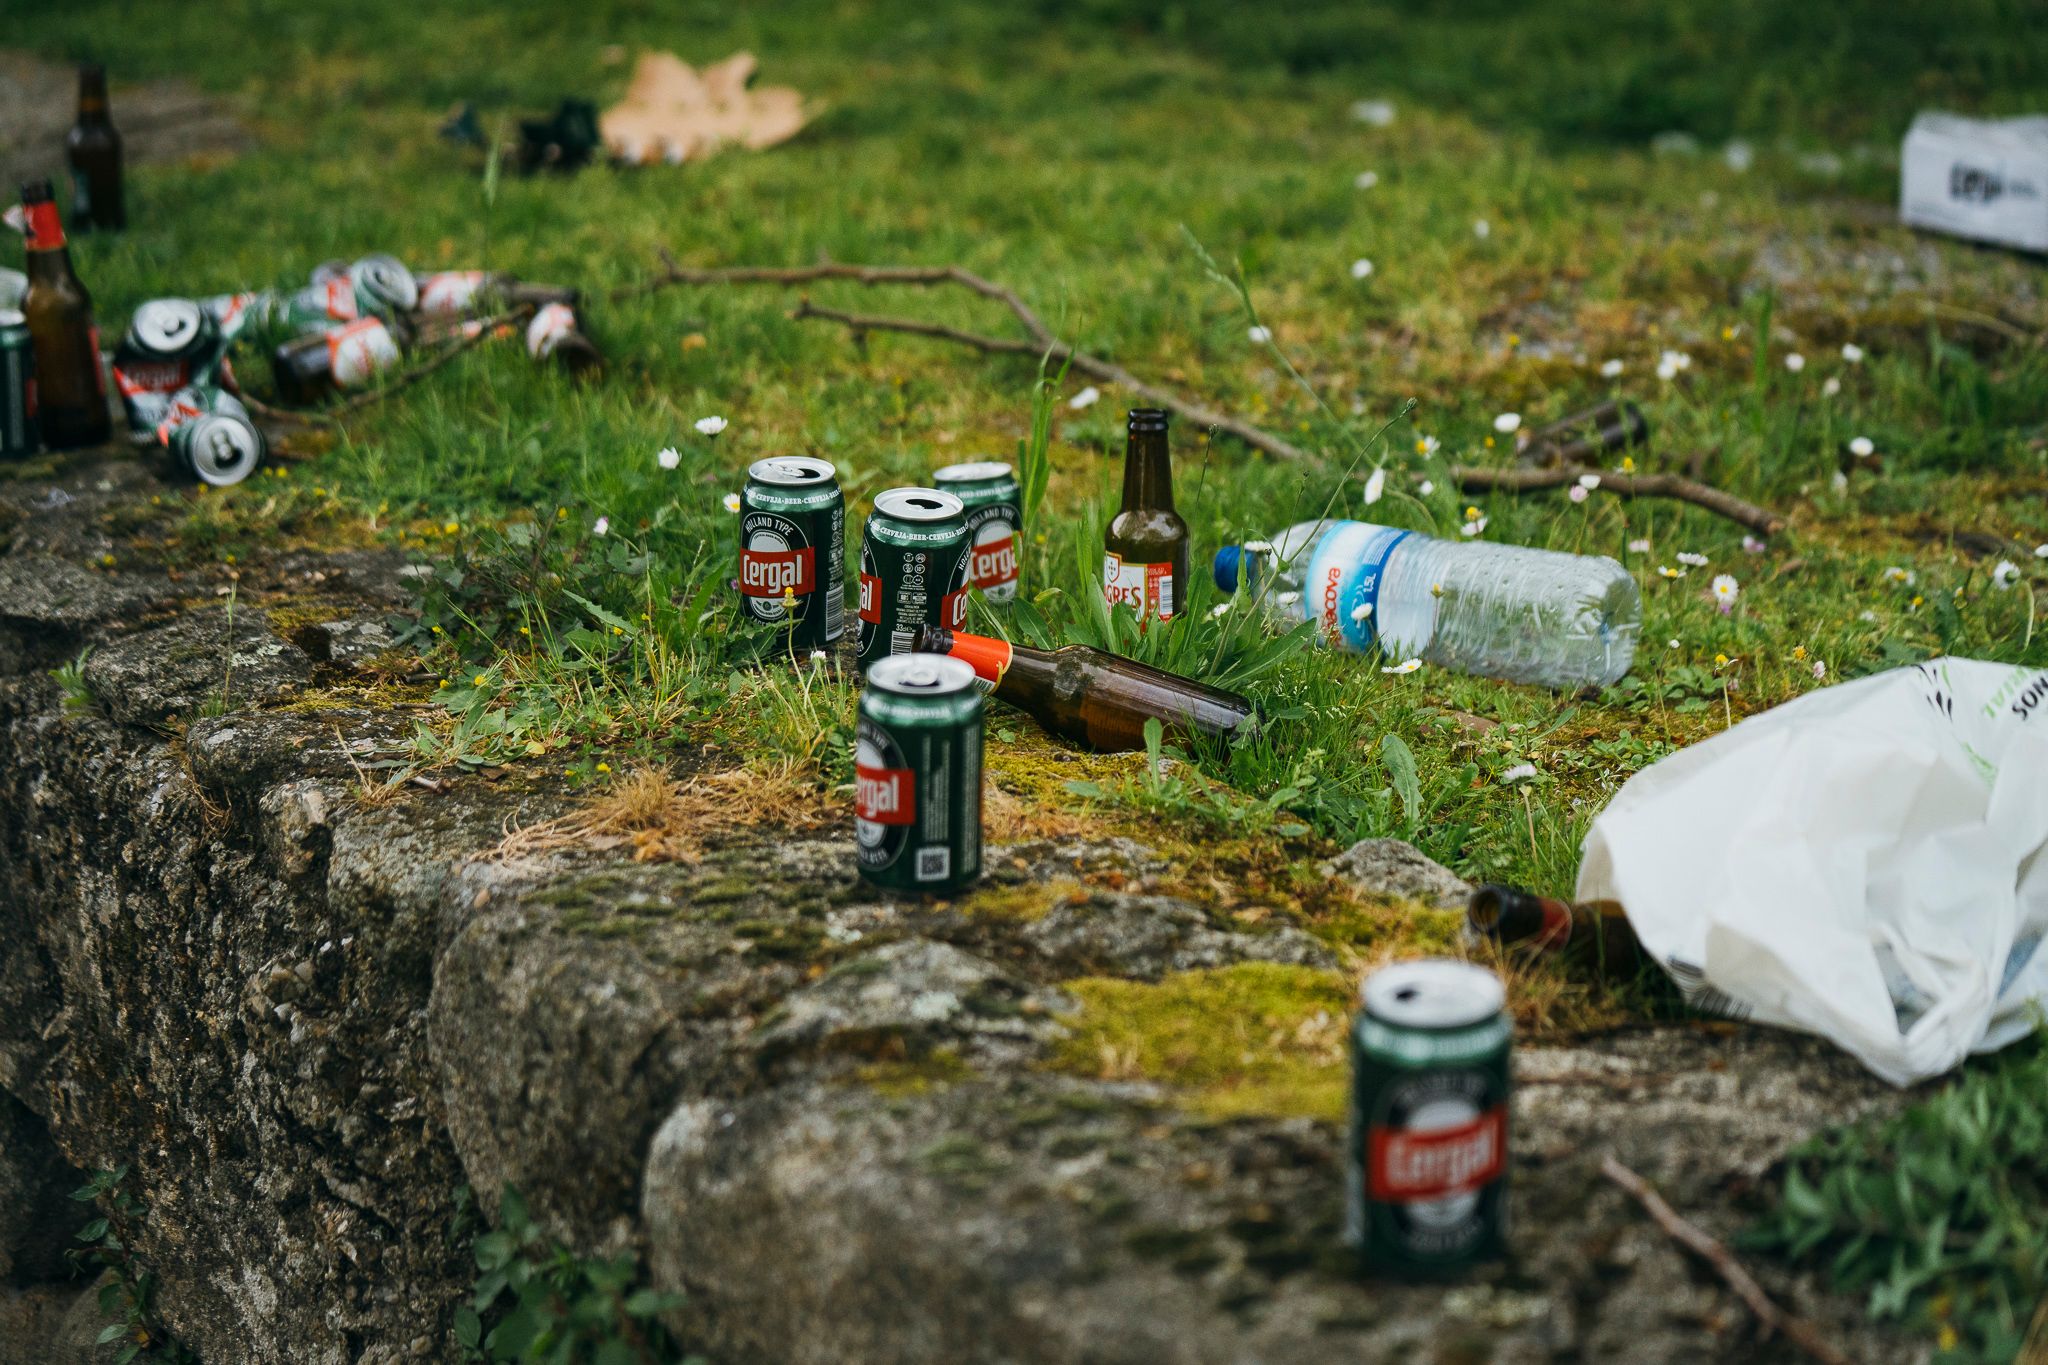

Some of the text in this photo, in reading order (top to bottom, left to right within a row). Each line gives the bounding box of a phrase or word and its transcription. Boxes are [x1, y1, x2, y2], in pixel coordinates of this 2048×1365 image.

[745, 516, 794, 536] HOLLAND TYPE
[743, 554, 802, 594] Cergal
